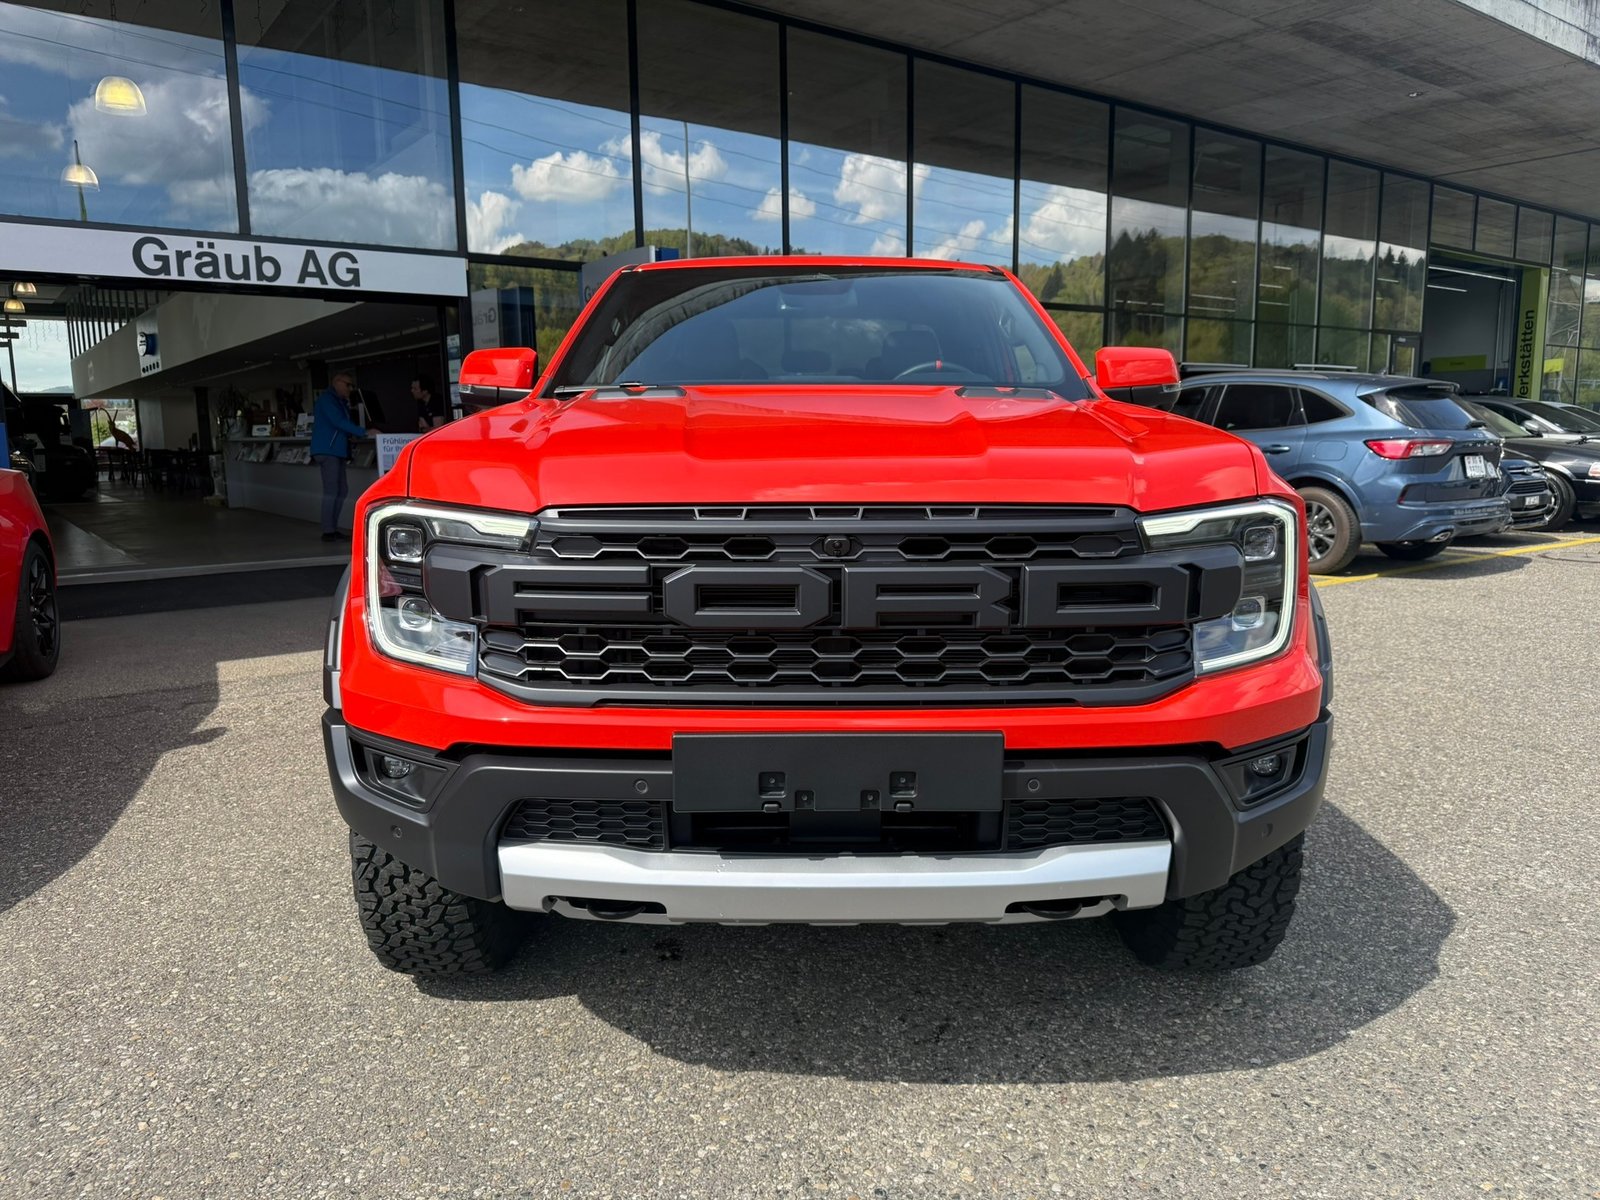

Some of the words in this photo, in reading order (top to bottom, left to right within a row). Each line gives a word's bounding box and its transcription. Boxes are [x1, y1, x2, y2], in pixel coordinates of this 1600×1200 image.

[132, 236, 282, 283] Gräub
[297, 249, 361, 288] AG
[480, 563, 1191, 628] FORD
